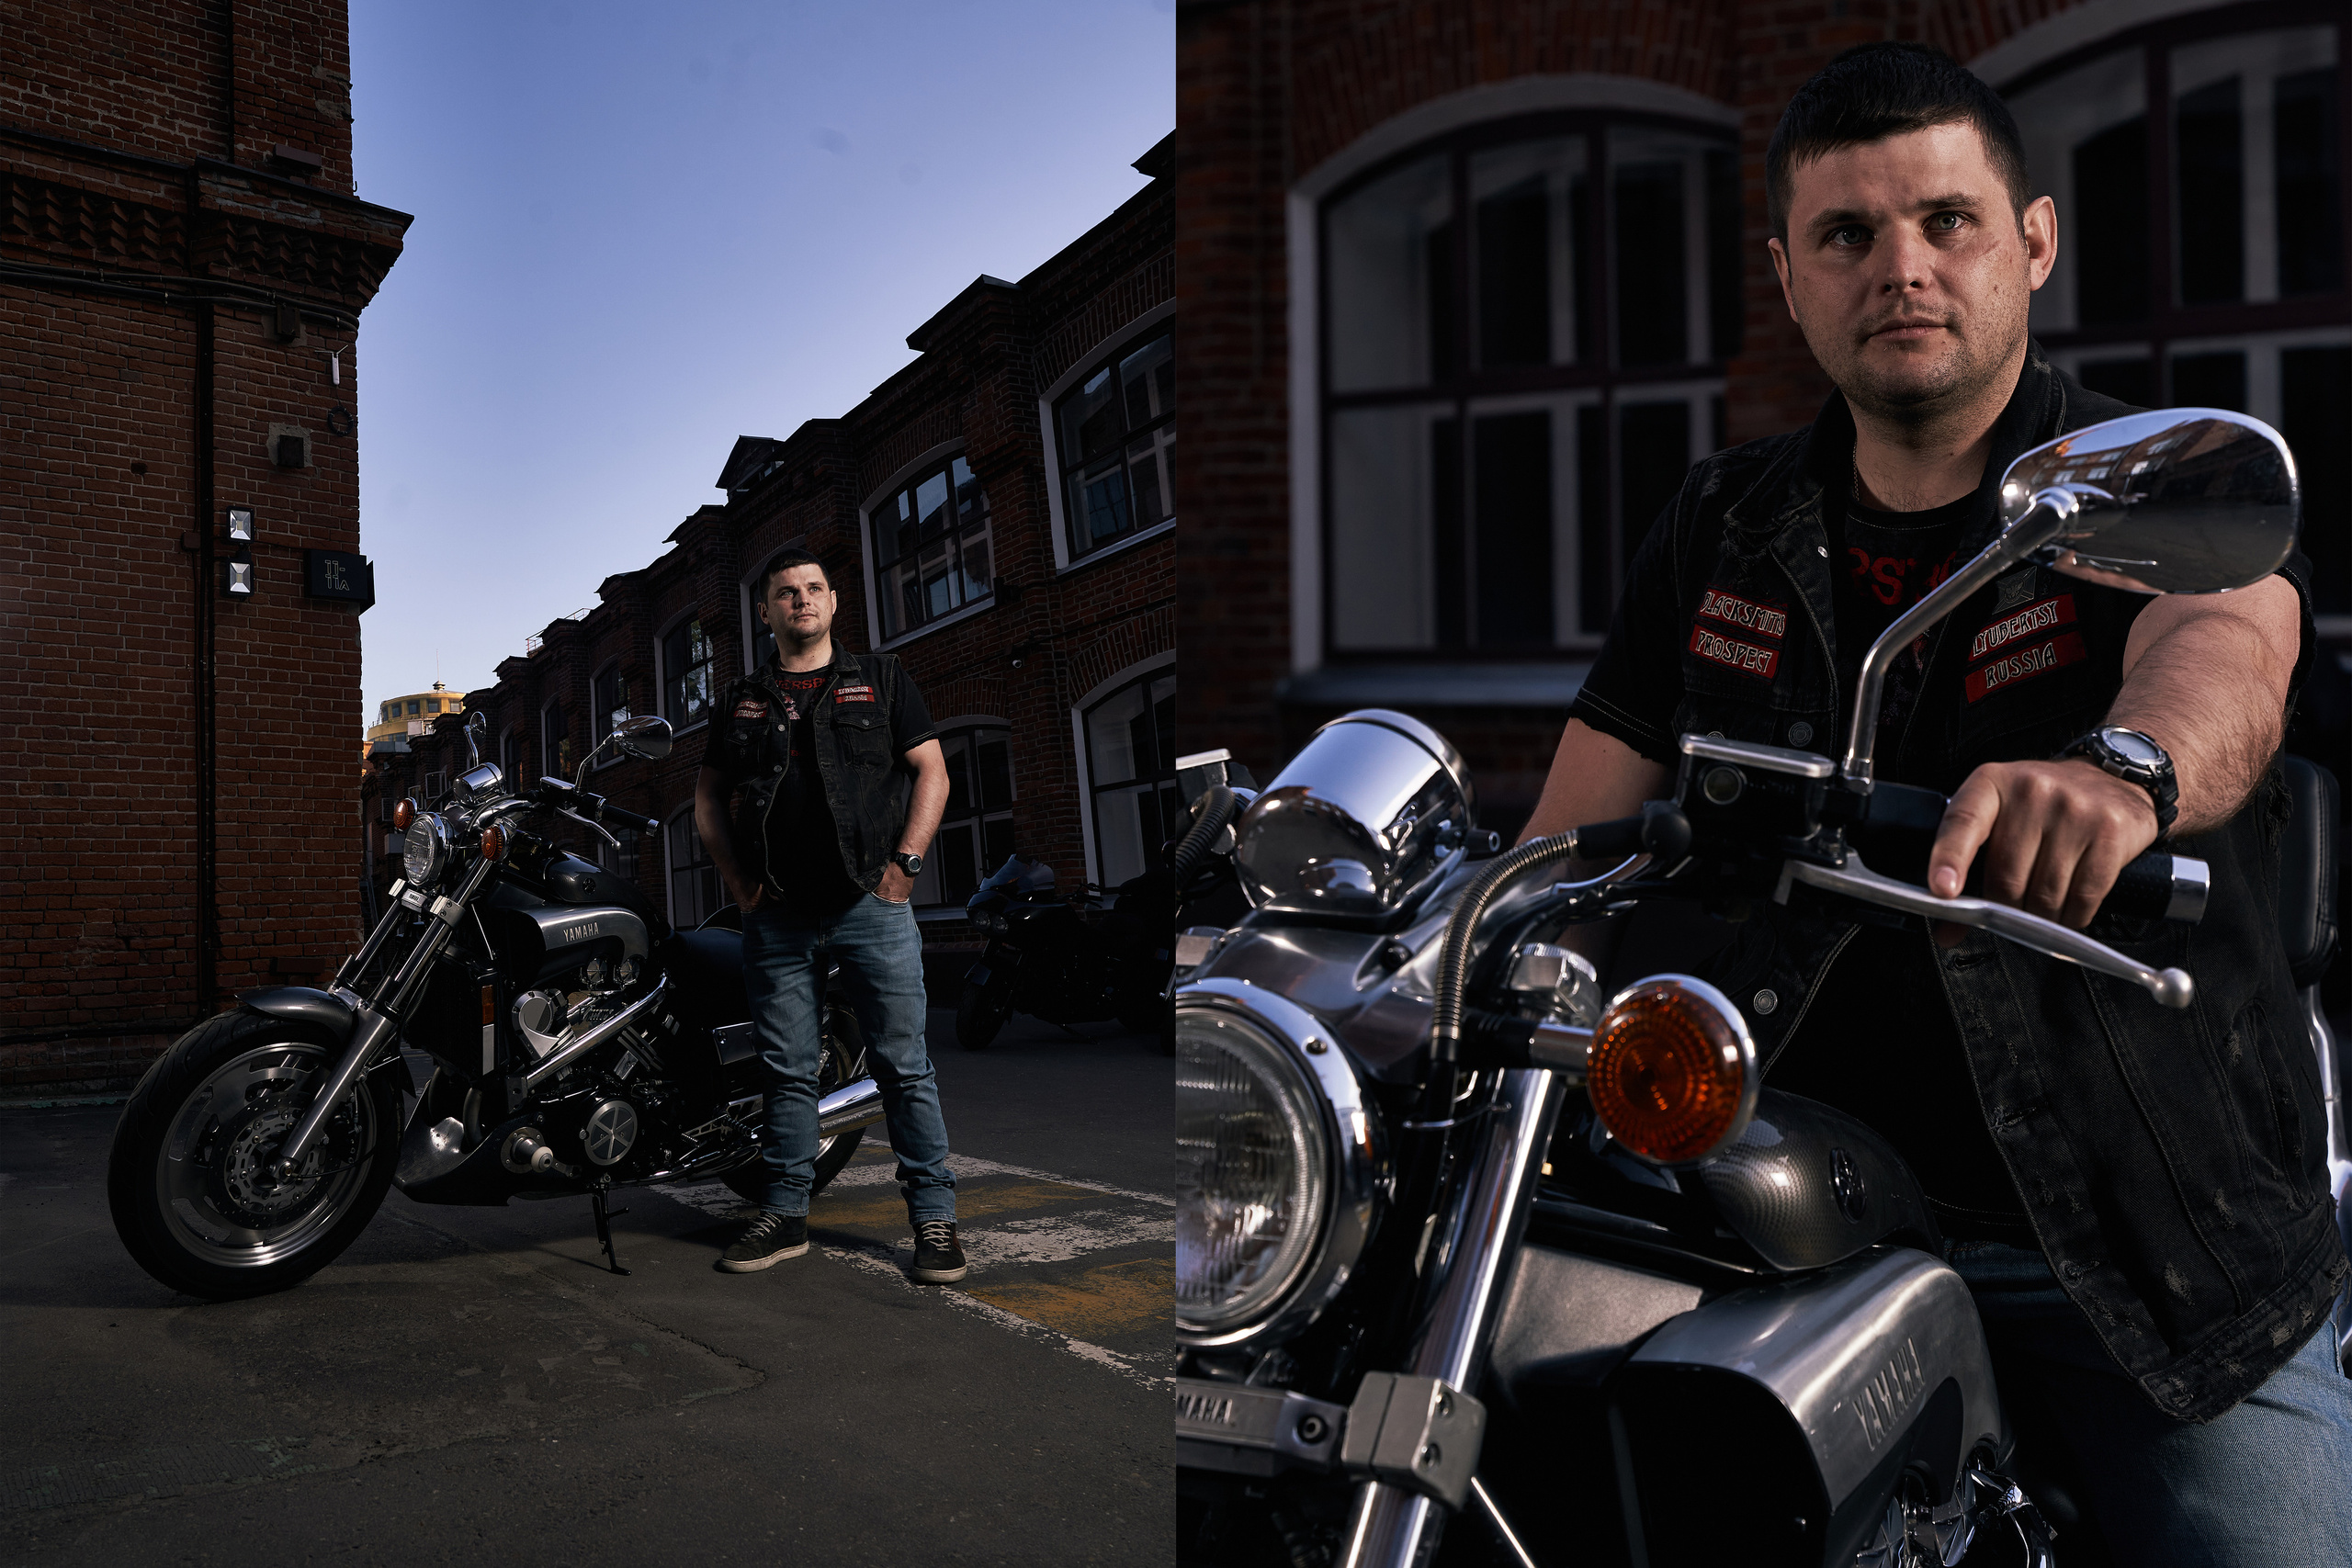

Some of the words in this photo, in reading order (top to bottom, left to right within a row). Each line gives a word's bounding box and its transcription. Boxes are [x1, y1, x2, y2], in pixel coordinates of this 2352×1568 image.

[1695, 630, 1773, 673] PROSPECT
[1973, 600, 2059, 657] LYUBERTSY
[1984, 642, 2058, 689] RUSSIA
[563, 921, 599, 942] YAMAHA
[1852, 1337, 1926, 1451] YAMAHA
